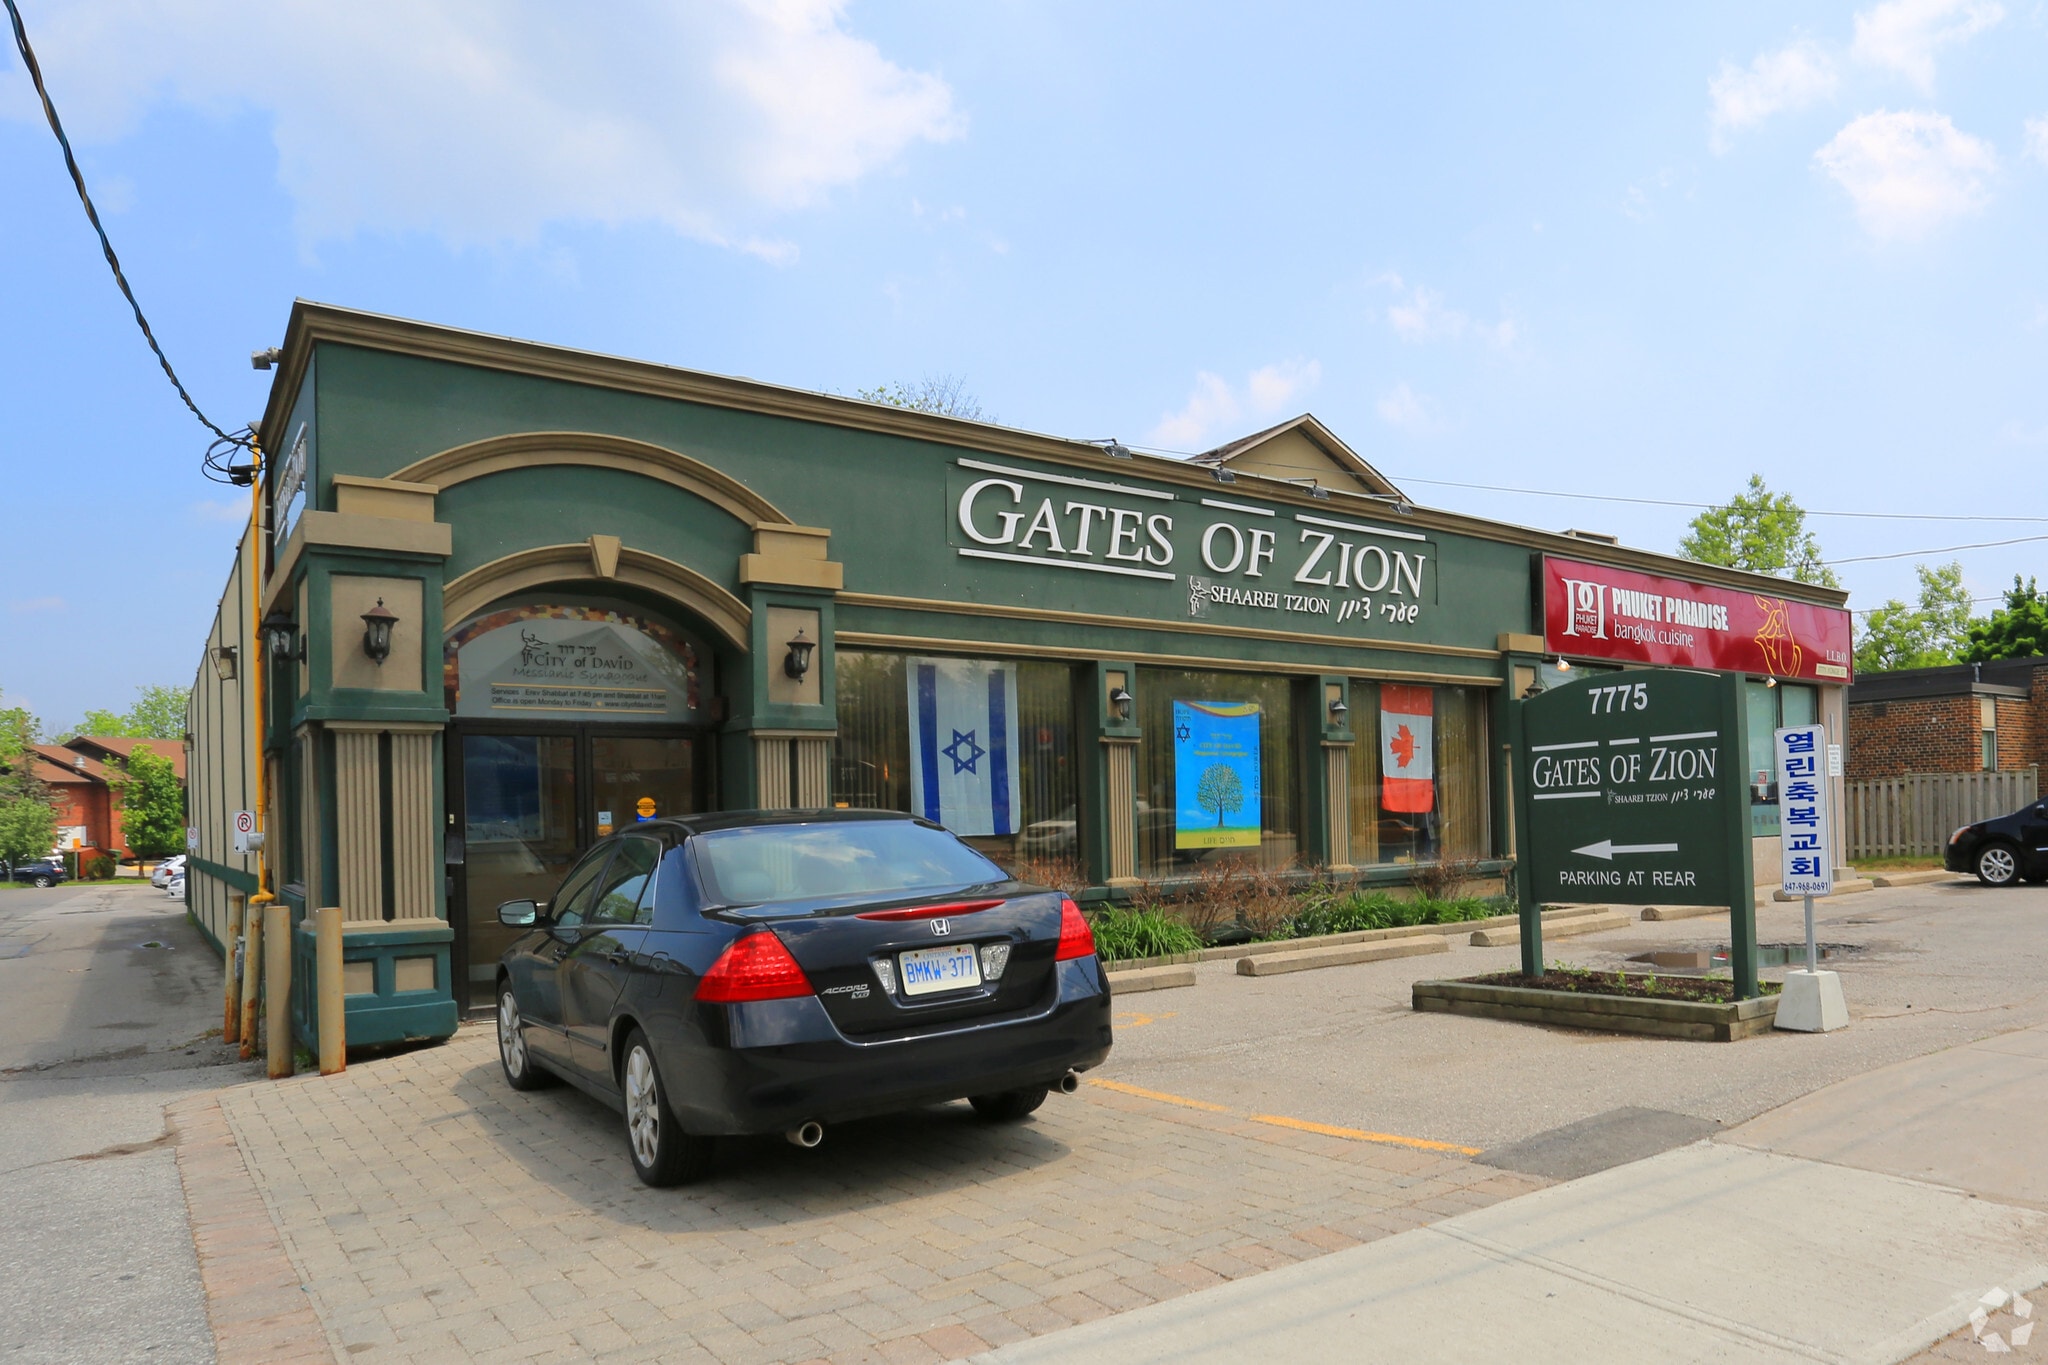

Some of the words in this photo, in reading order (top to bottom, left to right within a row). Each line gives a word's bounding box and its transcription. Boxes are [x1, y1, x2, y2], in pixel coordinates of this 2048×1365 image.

[957, 478, 1175, 567] GATES
[1200, 522, 1277, 578] OF
[1293, 529, 1426, 599] ZION
[1210, 585, 1279, 609] SHAAREI
[1284, 594, 1331, 615] TZION
[1336, 596, 1371, 624] ציון
[1611, 587, 1663, 622] PHUKET
[1665, 596, 1730, 632] PARADISE
[1380, 600, 1419, 624] שערי
[1575, 613, 1597, 625] PHUKET
[1614, 618, 1657, 645] bangkok
[1658, 628, 1695, 648] cuisine
[574, 656, 587, 667] of
[512, 667, 575, 679] Messianic
[580, 669, 648, 685] Synagogue
[492, 696, 511, 704] Office
[520, 698, 537, 706] open
[537, 698, 563, 707] Monday
[1588, 683, 1649, 715] 7775
[1532, 756, 1601, 788] GATES
[1609, 754, 1641, 784] OF
[1649, 747, 1717, 781] ZION
[1614, 793, 1644, 804] SHAAREI
[1646, 793, 1668, 802] TZION
[1670, 788, 1689, 804] ציון
[1693, 788, 1716, 801] שערי
[1783, 731, 1822, 878] 열린축복교회
[1559, 870, 1621, 886] PARKING
[1627, 870, 1645, 886] AT
[1652, 871, 1697, 887] REAR
[1784, 881, 1828, 892] 647-968-0691
[905, 959, 942, 984] BMKW
[948, 955, 973, 977] 377
[821, 984, 868, 995] ACCORD
